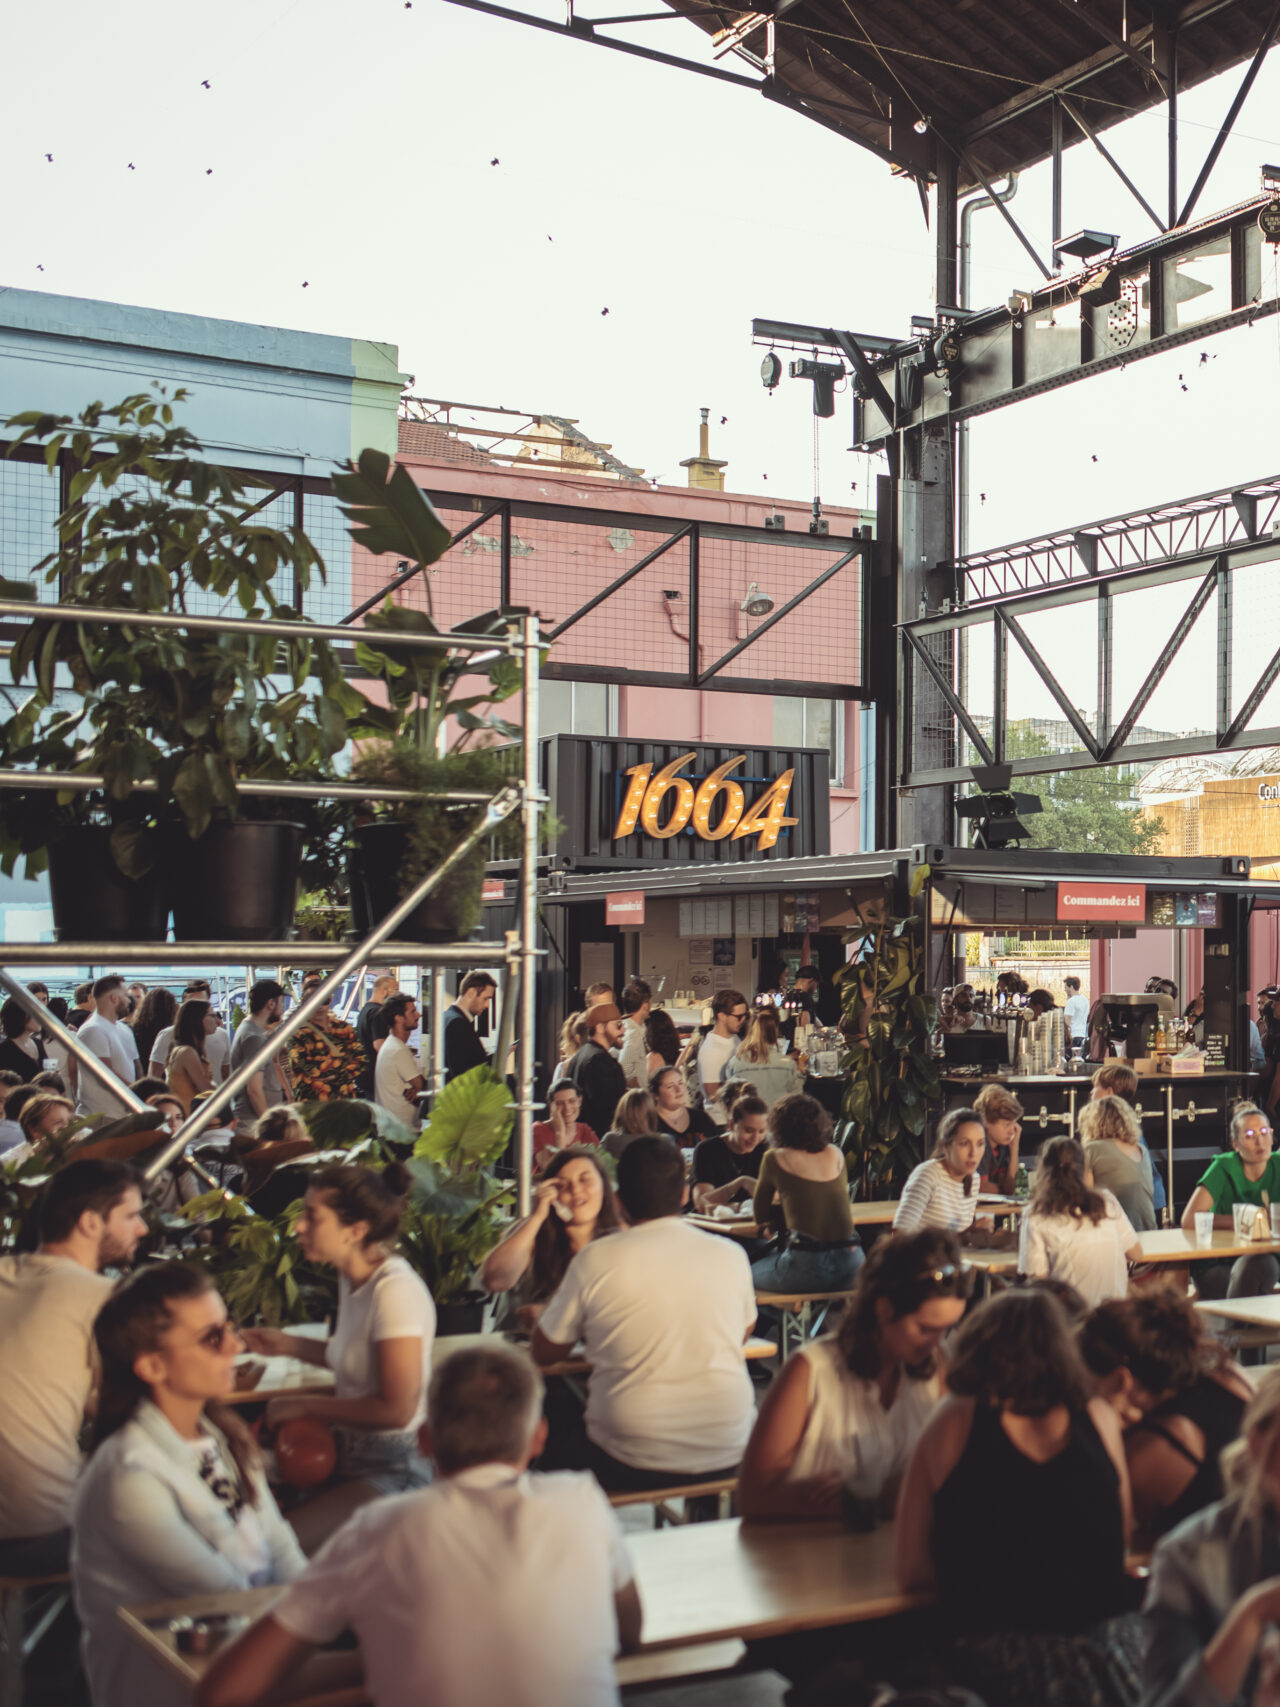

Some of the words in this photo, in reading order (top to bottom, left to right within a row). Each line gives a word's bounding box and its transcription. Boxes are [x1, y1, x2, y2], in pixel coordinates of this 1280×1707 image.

[613, 751, 799, 851] 1664
[1063, 894, 1126, 906] Commandez
[1127, 895, 1140, 906] ici
